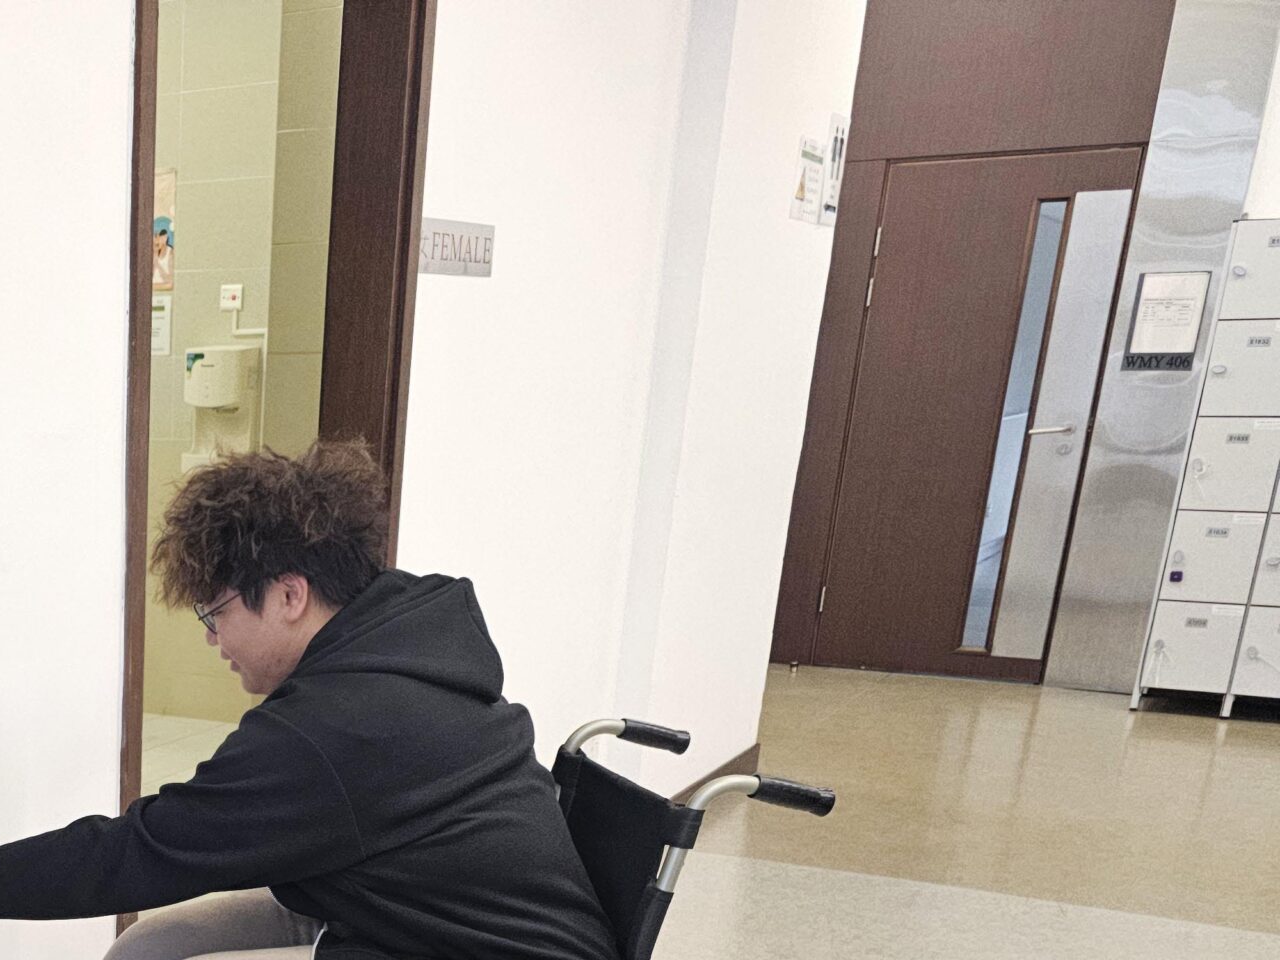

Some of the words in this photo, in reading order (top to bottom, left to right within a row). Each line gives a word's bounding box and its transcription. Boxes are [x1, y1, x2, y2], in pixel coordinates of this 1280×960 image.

[431, 231, 492, 265] FEMALE
[1125, 355, 1165, 369] WMY
[1166, 354, 1191, 369] 406
